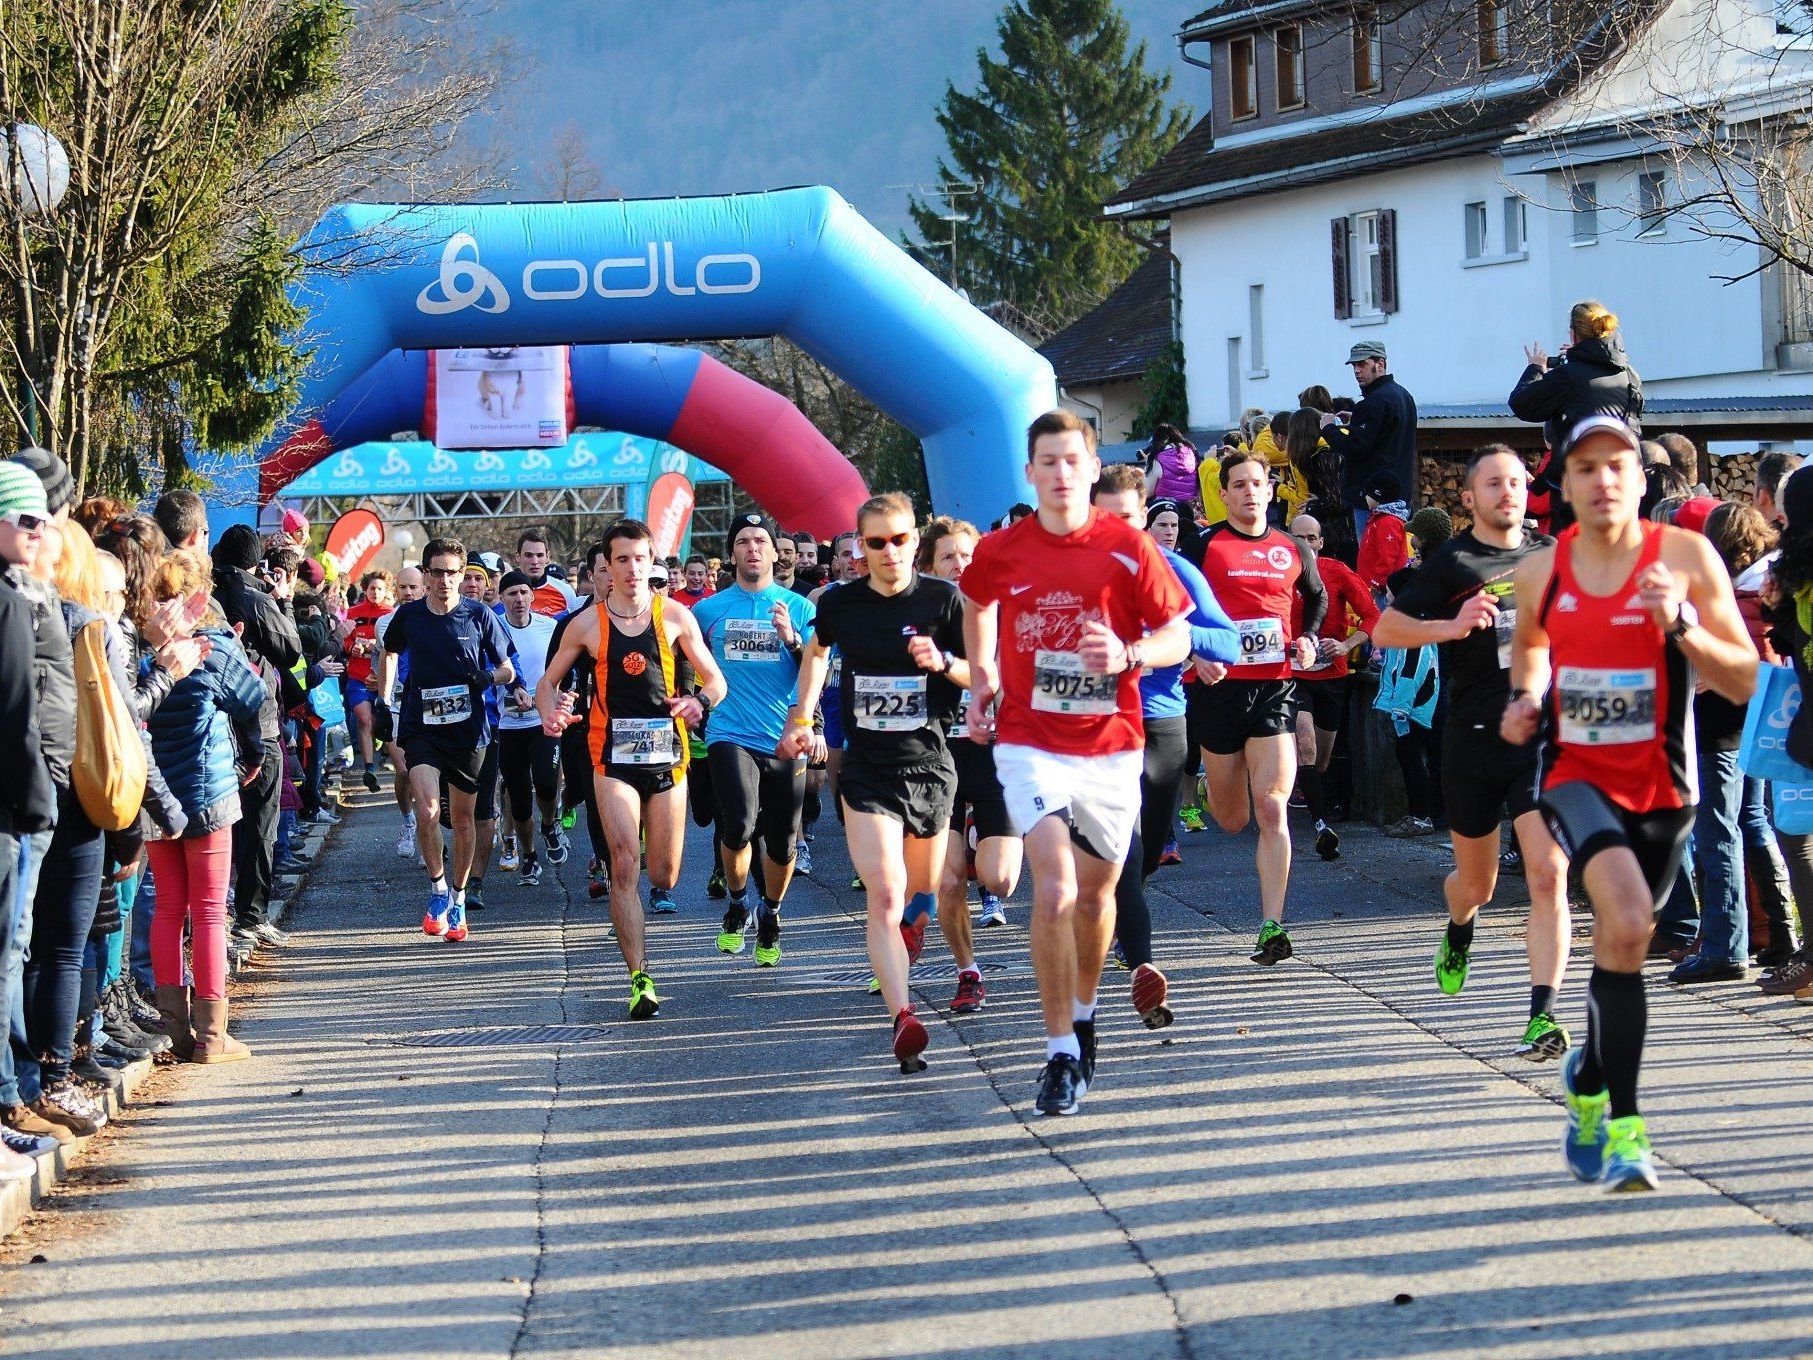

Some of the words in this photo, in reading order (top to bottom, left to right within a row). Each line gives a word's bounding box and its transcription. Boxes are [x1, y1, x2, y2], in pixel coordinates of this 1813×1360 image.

[522, 241, 761, 300] odlo
[517, 471, 557, 483] odlo
[563, 469, 603, 481] odlo
[611, 466, 649, 478] odlo
[328, 478, 370, 490] odlo
[376, 476, 417, 489] odlo
[423, 475, 464, 487] odlo
[470, 473, 510, 485] odlo
[740, 632, 766, 640] ROBERT
[430, 697, 466, 716] 1132
[862, 695, 920, 717] 1225
[631, 741, 655, 753] 741
